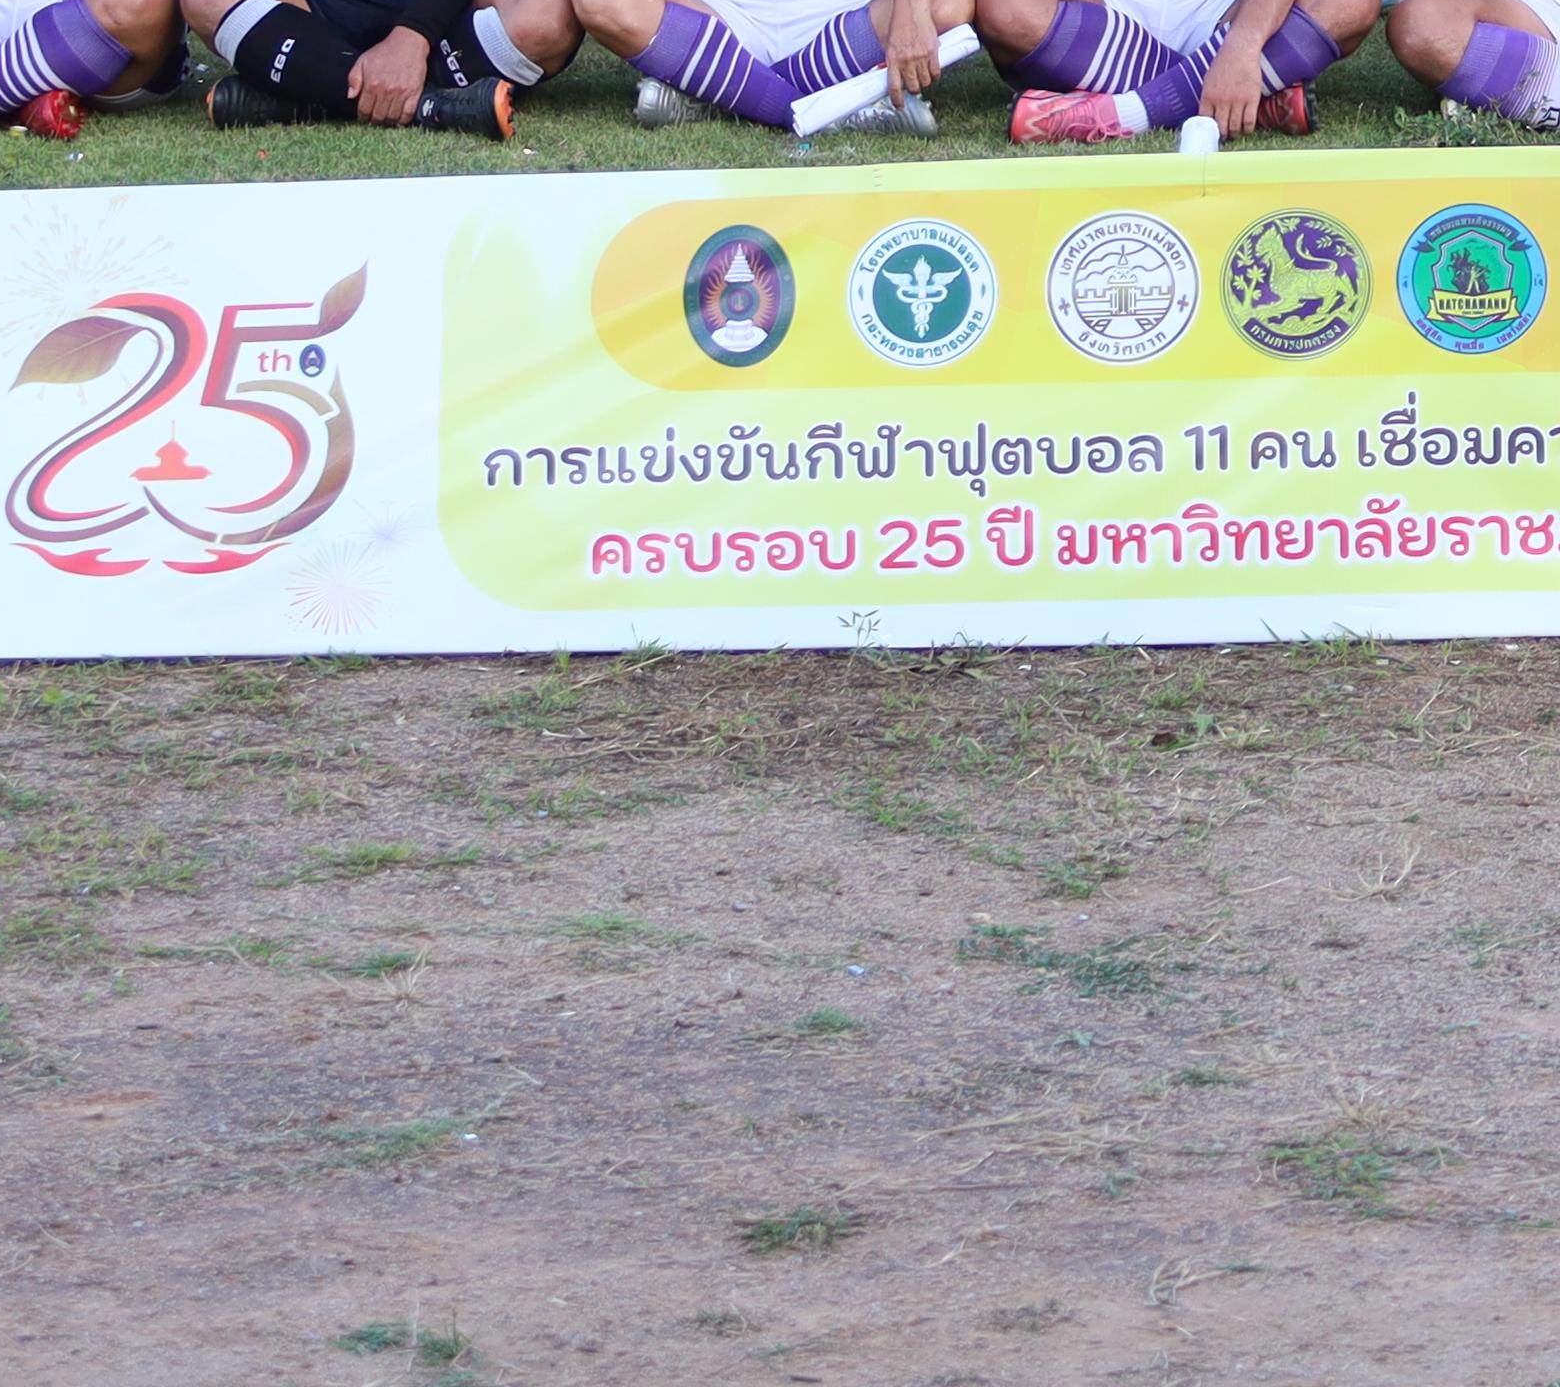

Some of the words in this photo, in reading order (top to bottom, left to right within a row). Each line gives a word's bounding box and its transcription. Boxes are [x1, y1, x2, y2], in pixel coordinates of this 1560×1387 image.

[270, 37, 296, 84] EGO
[257, 348, 292, 374] th
[483, 420, 1164, 499] การแข่งขันกีฬาฟุตบอล
[1183, 427, 1230, 472] 11
[1248, 428, 1338, 471] คน
[588, 518, 855, 579] ครบรอบ
[878, 516, 967, 571] 25
[985, 500, 1038, 570] ปี
